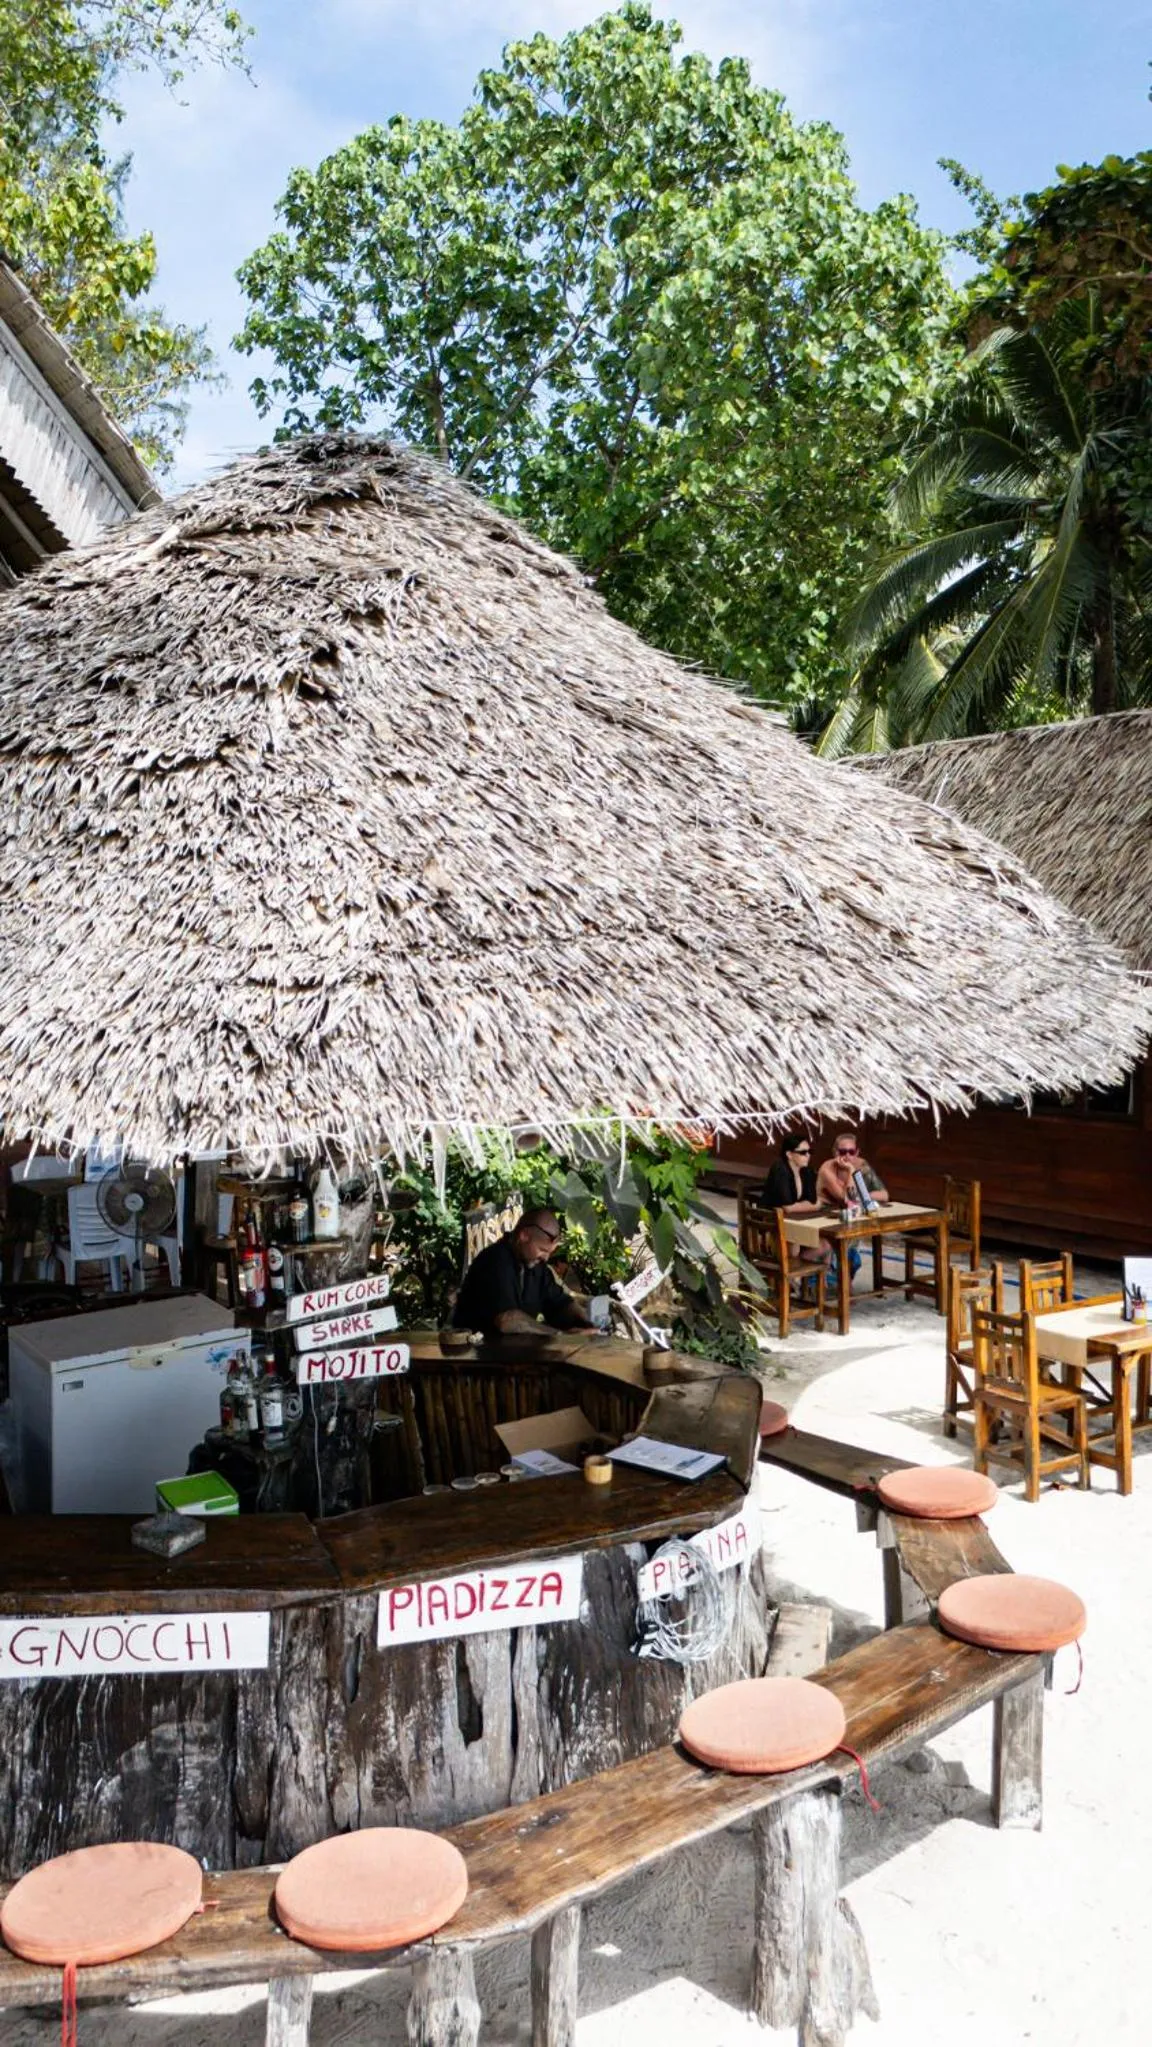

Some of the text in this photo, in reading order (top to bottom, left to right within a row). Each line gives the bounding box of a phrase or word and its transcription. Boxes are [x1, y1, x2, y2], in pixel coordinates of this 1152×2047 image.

[303, 1279, 386, 1314] RUM COKE
[312, 1314, 374, 1342] SHAKE
[652, 1522, 748, 1592] PIAINA
[389, 1572, 563, 1631] PIADIZZA
[9, 1622, 231, 1667] GNOCCHI
